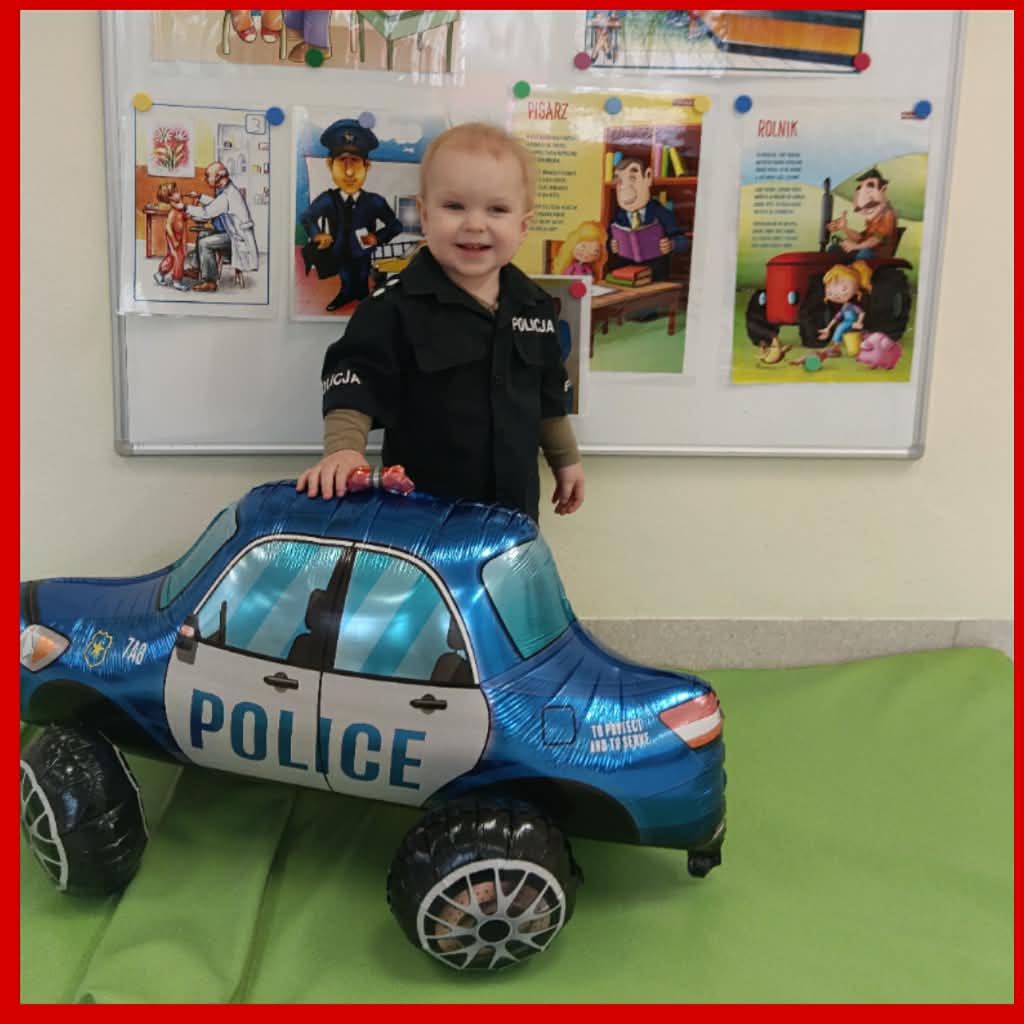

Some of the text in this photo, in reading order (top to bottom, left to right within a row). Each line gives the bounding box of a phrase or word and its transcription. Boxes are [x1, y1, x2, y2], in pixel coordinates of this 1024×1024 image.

[527, 100, 569, 121] PISARZ
[758, 119, 799, 138] ROLNIK
[512, 316, 555, 333] POLICJA
[190, 687, 427, 791] POLICE
